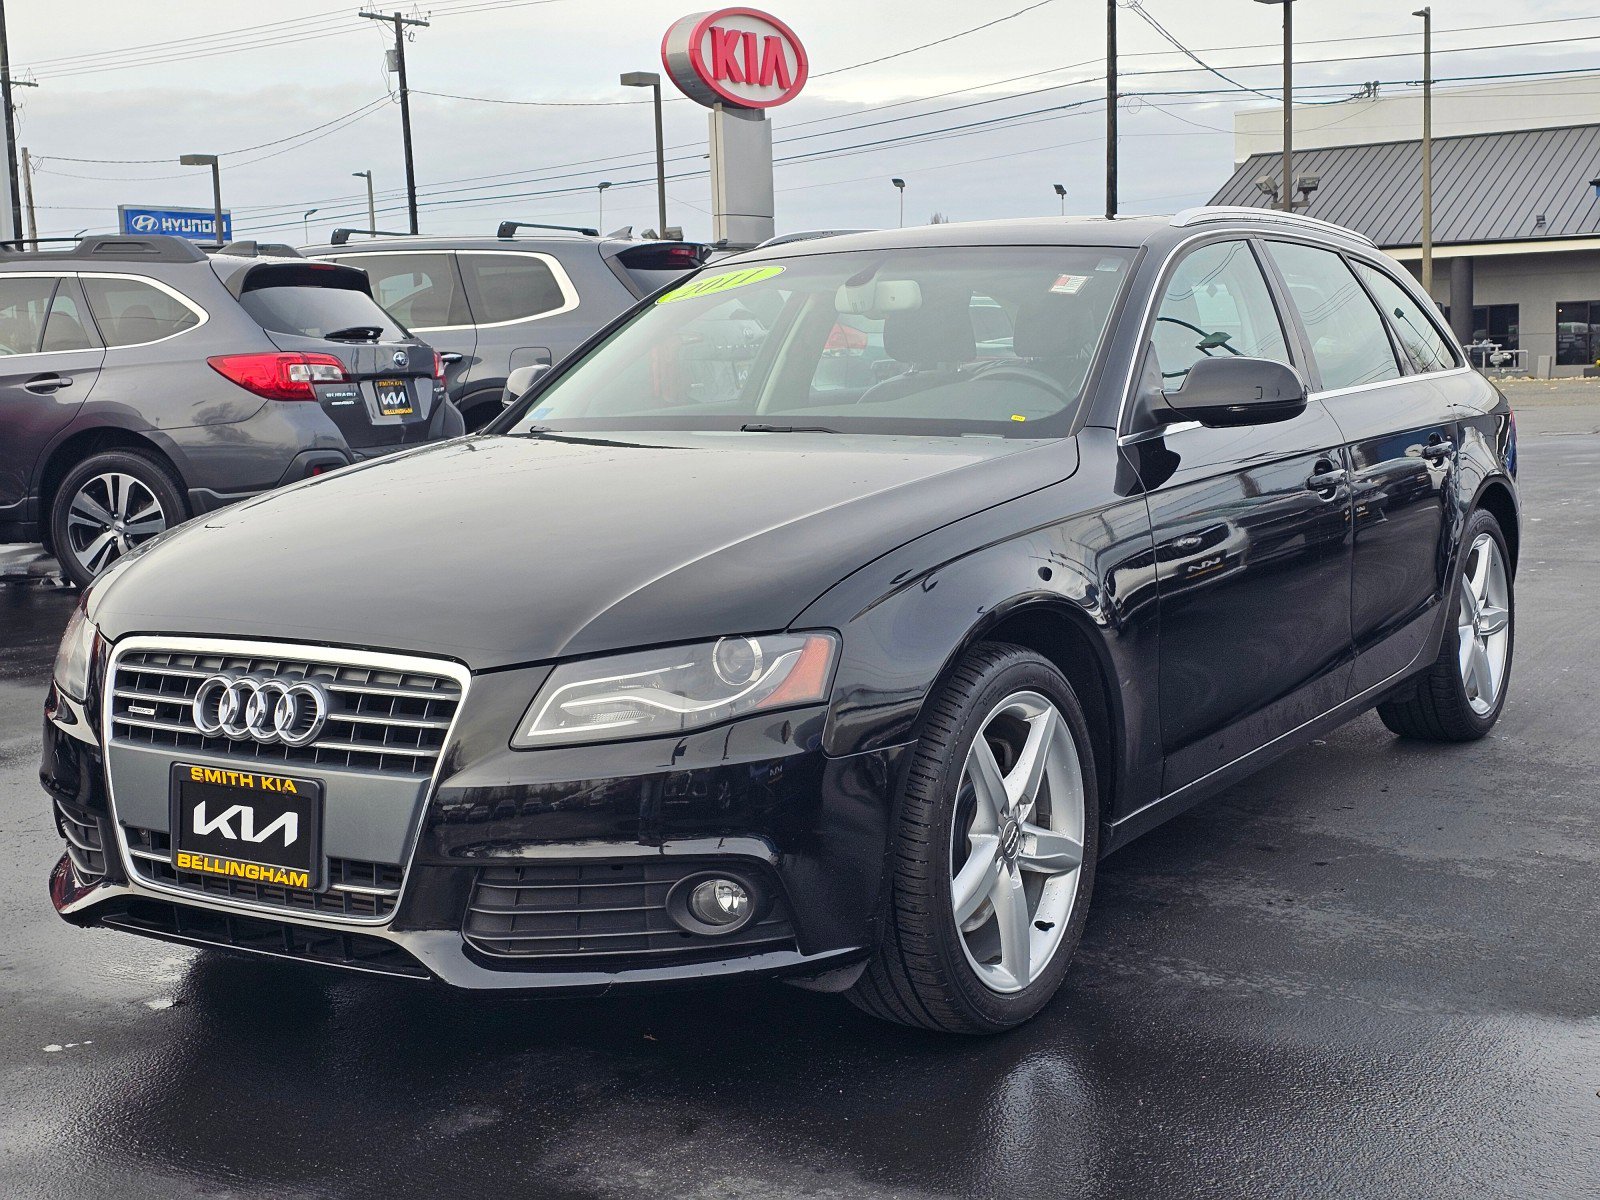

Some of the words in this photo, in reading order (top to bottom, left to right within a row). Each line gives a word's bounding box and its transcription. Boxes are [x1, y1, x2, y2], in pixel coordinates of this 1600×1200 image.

[709, 26, 791, 90] KIA
[381, 391, 405, 405] KIA
[190, 766, 254, 788] SMITH
[261, 776, 297, 794] KIA
[193, 800, 298, 848] KIA
[177, 853, 308, 888] BELLINGHAM
